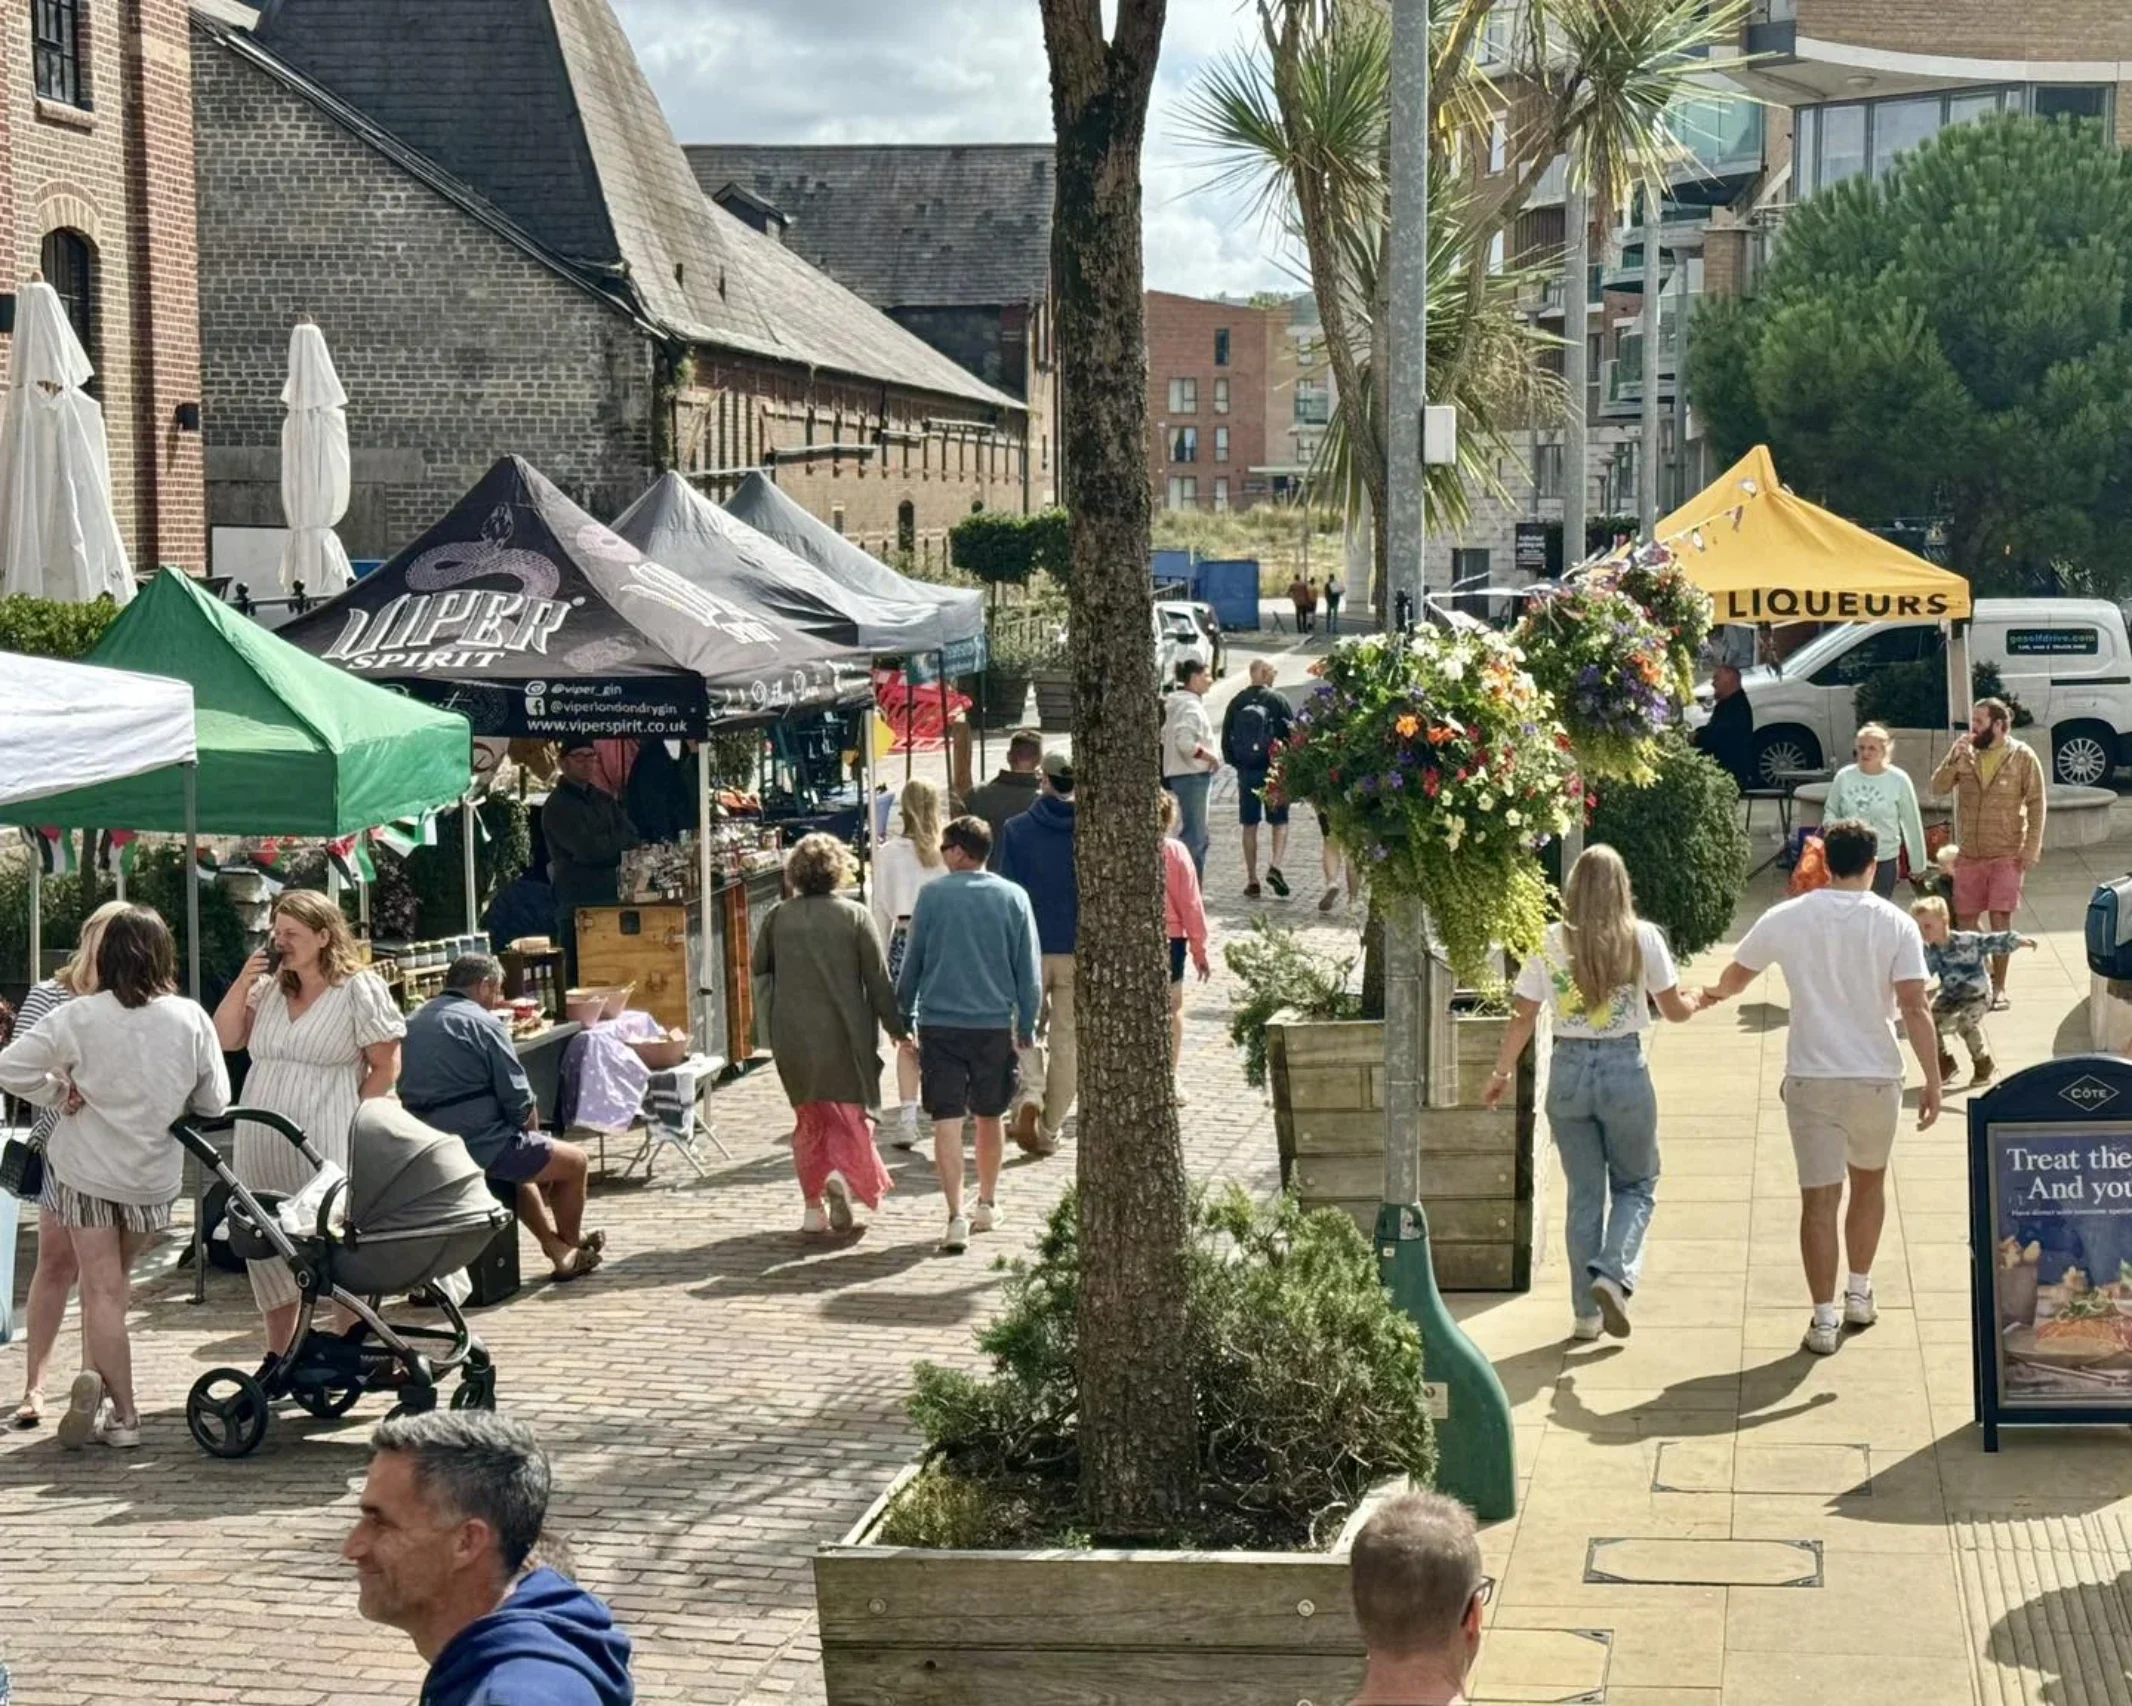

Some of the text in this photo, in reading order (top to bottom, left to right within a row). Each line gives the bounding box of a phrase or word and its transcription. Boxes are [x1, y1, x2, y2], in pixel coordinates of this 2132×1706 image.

[1728, 588, 1948, 618] LIQUEURS
[321, 589, 572, 661] VIPER
[347, 651, 505, 672] SPIRIT
[551, 683, 622, 696] @viper_gin
[551, 701, 677, 717] @viperlondondrygin
[527, 719, 688, 735] www.viperspirit.co.uk
[2071, 1087, 2107, 1099] CÔTE
[2006, 1145, 2132, 1171] Treat the
[2028, 1175, 2084, 1199] And
